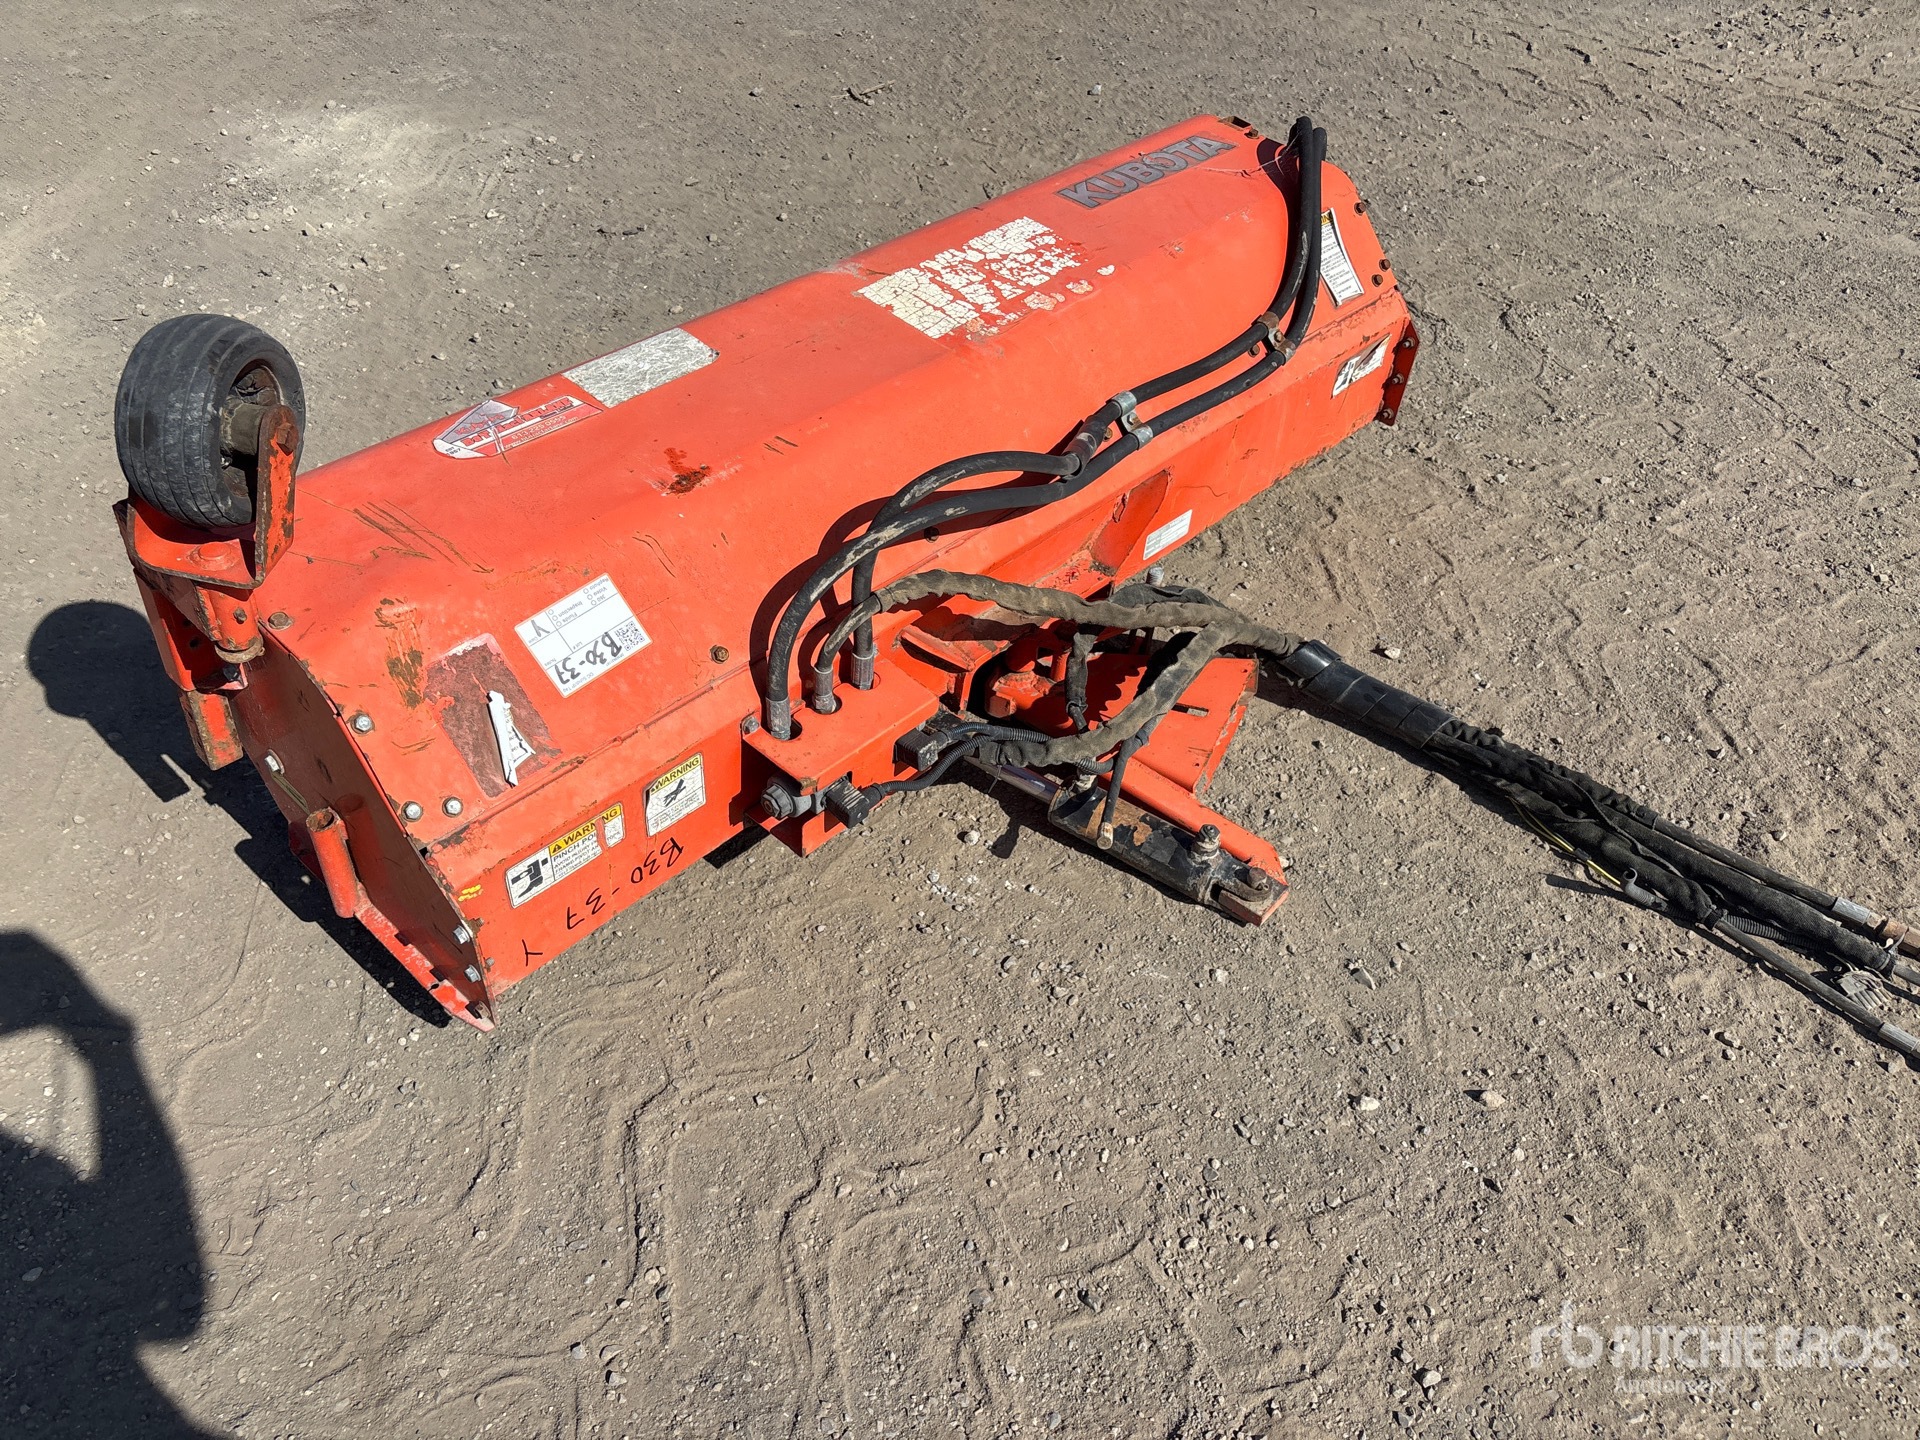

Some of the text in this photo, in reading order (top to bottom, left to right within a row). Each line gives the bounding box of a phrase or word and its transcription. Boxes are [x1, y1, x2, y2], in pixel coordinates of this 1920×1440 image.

[1055, 135, 1237, 208] KUBOTA
[593, 586, 608, 596] Video
[558, 600, 583, 617] Inspection
[554, 631, 623, 685] B30-37
[654, 757, 700, 790] WARNING
[563, 807, 618, 846] WARNNG
[553, 843, 580, 862] PINCH
